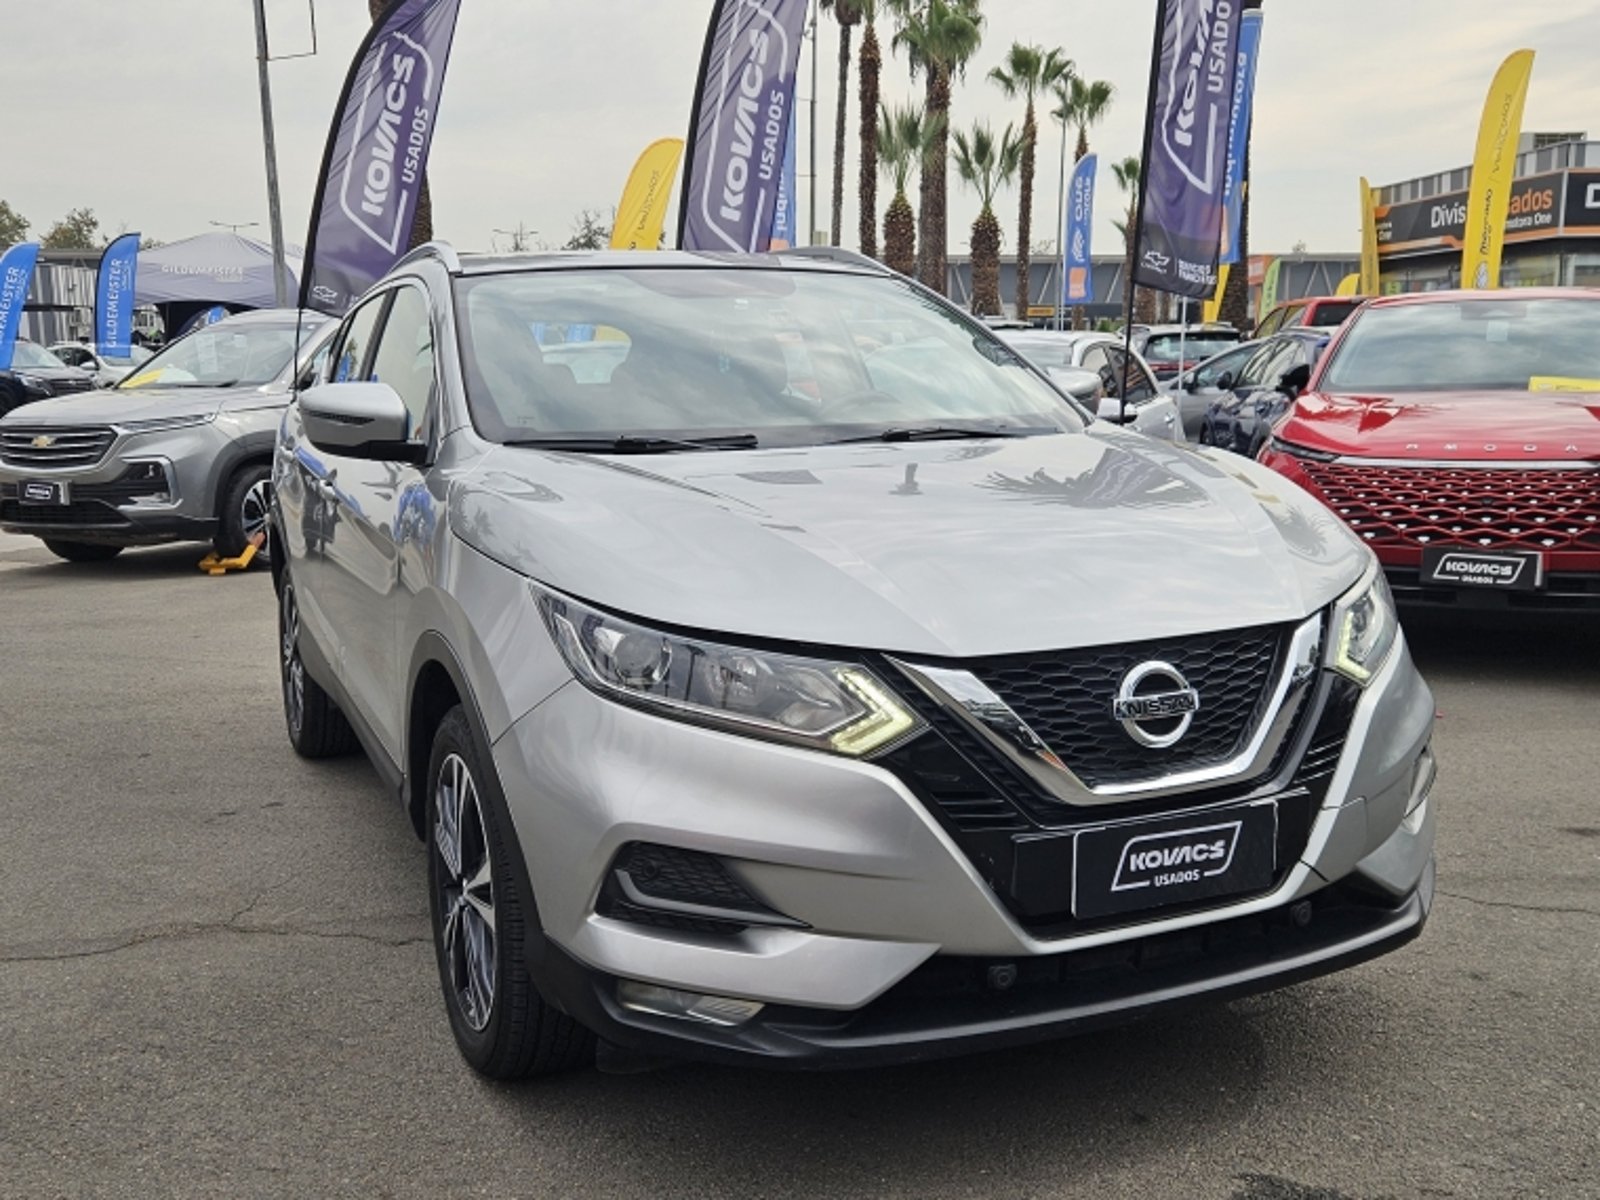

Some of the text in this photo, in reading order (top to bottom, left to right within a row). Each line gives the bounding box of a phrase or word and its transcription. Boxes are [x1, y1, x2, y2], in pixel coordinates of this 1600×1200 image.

[361, 53, 416, 217] KOVACS
[401, 105, 430, 185] USADOS
[719, 29, 770, 222] KOVACS
[758, 89, 785, 181] USADOS
[1430, 202, 1467, 229] Divis
[1508, 188, 1553, 215] ados
[106, 259, 123, 348] GILDEMEISTER
[1446, 561, 1513, 576] KOVACS
[1126, 694, 1197, 716] NISSAN
[1129, 839, 1226, 872] KOVACS
[1154, 869, 1200, 887] USADOS
